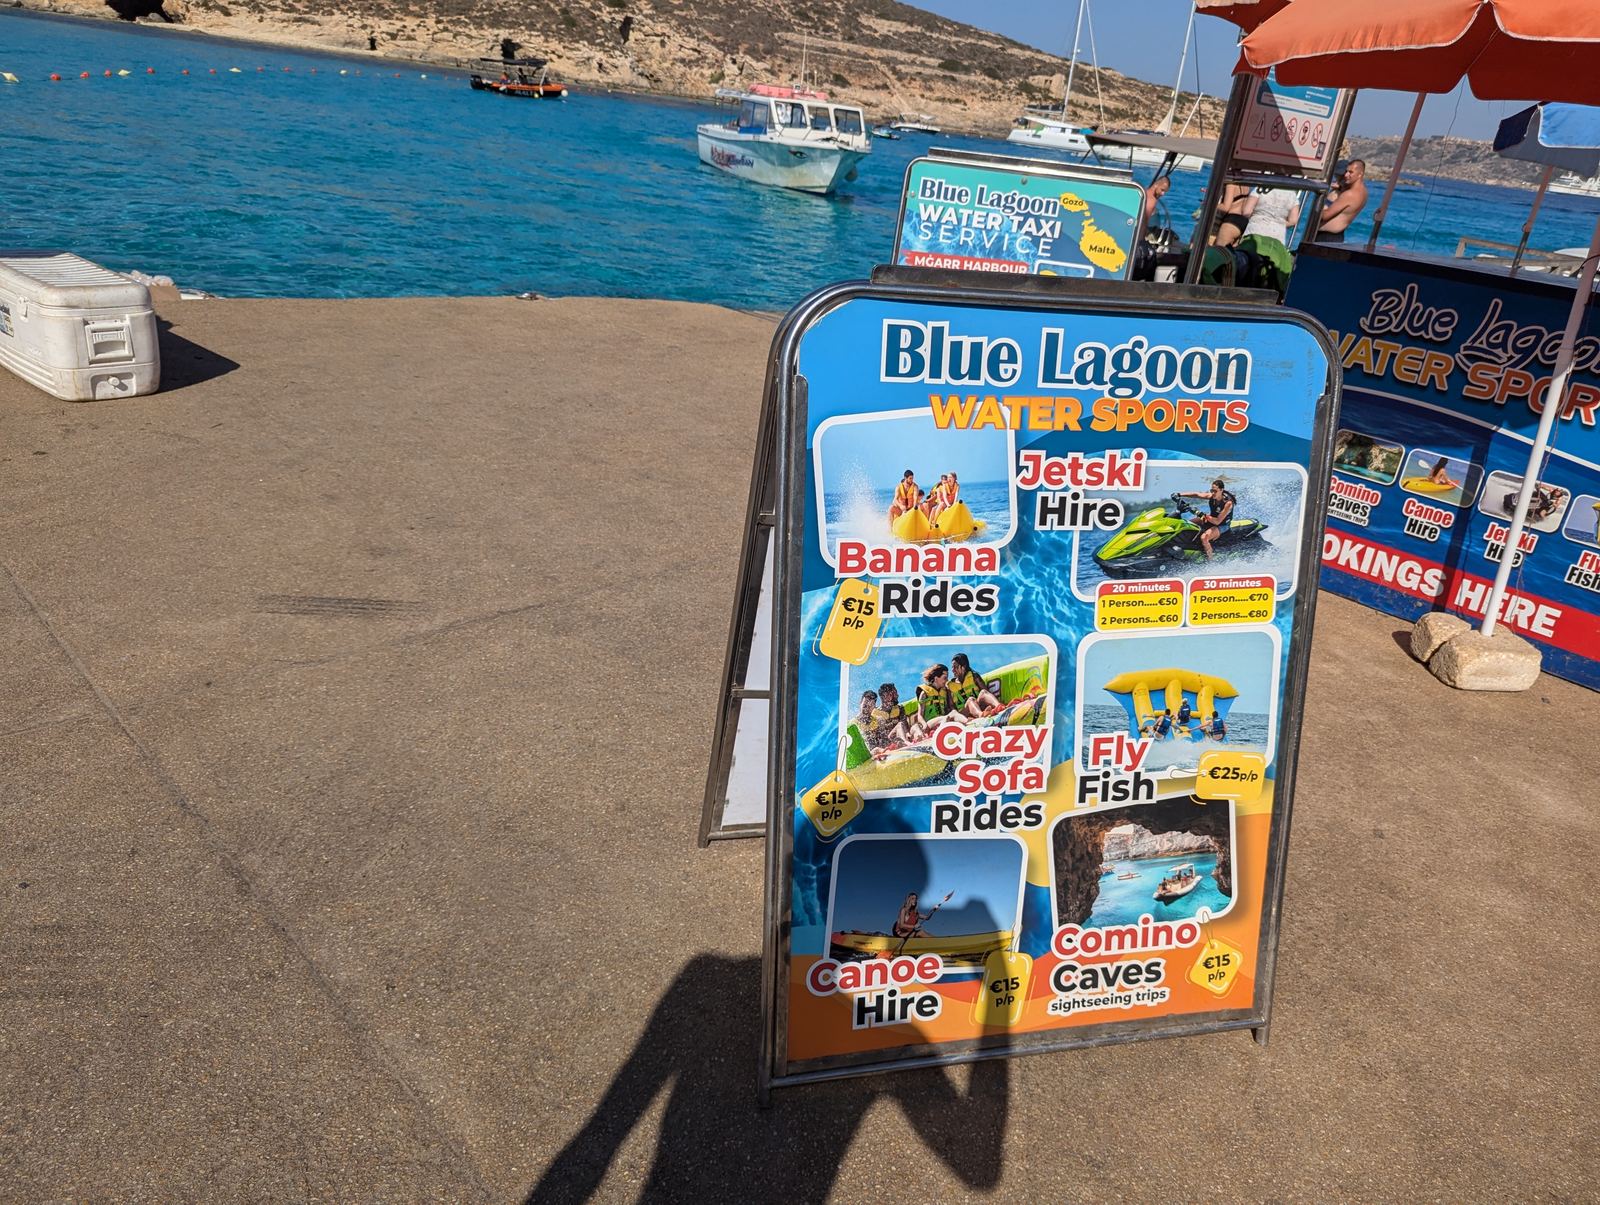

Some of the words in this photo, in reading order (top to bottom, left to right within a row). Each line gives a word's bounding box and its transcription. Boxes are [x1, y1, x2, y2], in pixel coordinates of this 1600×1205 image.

[919, 177, 971, 204] Blue
[976, 184, 1060, 218] Lagoon
[1062, 197, 1084, 207] Gozo
[918, 203, 1003, 231] WATER
[1008, 214, 1062, 239] TAXI
[918, 221, 1054, 257] SERVICE
[1088, 243, 1116, 256] Malta
[963, 259, 1029, 275] HARBOUR
[1359, 283, 1458, 341] Blue
[1457, 298, 1600, 371] Lagoo
[883, 321, 1020, 385] Blue
[1040, 330, 1250, 399] Lagoon
[929, 395, 1083, 431] WATER
[1090, 397, 1251, 433] SPORTS
[1018, 450, 1145, 488] Jetski
[1330, 476, 1380, 506] Comino
[1037, 490, 1122, 528] Hire
[1328, 493, 1369, 518] Caves
[1403, 499, 1453, 527] Canoe
[1405, 518, 1439, 540] Hire
[1484, 523, 1538, 552] Jetki
[837, 541, 998, 575] Banana
[1485, 542, 1522, 566] Hie
[880, 577, 997, 615] Rides
[1112, 583, 1126, 593] 20
[1128, 582, 1171, 593] minutes
[1203, 580, 1217, 589] 30
[1219, 579, 1262, 589] minutes
[842, 597, 875, 616] €15
[1101, 600, 1106, 608] 1
[1192, 595, 1197, 604] 1
[1454, 579, 1563, 638] HERE
[842, 615, 865, 630] p/p
[1101, 617, 1107, 625] 2
[1192, 612, 1199, 621] 2
[934, 725, 1049, 758] Crazy
[1090, 734, 1150, 772] Fly
[956, 759, 1045, 794] Sofa
[1077, 770, 1155, 804] Fish
[815, 789, 849, 806] €15
[821, 806, 843, 821] p/p
[934, 797, 1044, 834] Rides
[1053, 916, 1199, 956] Comino
[809, 956, 941, 993] Canoe
[1202, 953, 1231, 970] €15
[990, 976, 1020, 994] €15
[1052, 960, 1163, 993] Caves
[1207, 970, 1226, 983] p/p
[855, 988, 940, 1026] Hire
[995, 993, 1015, 1008] p/p
[1051, 991, 1132, 1012] sightseeing
[1135, 989, 1167, 1005] trips
